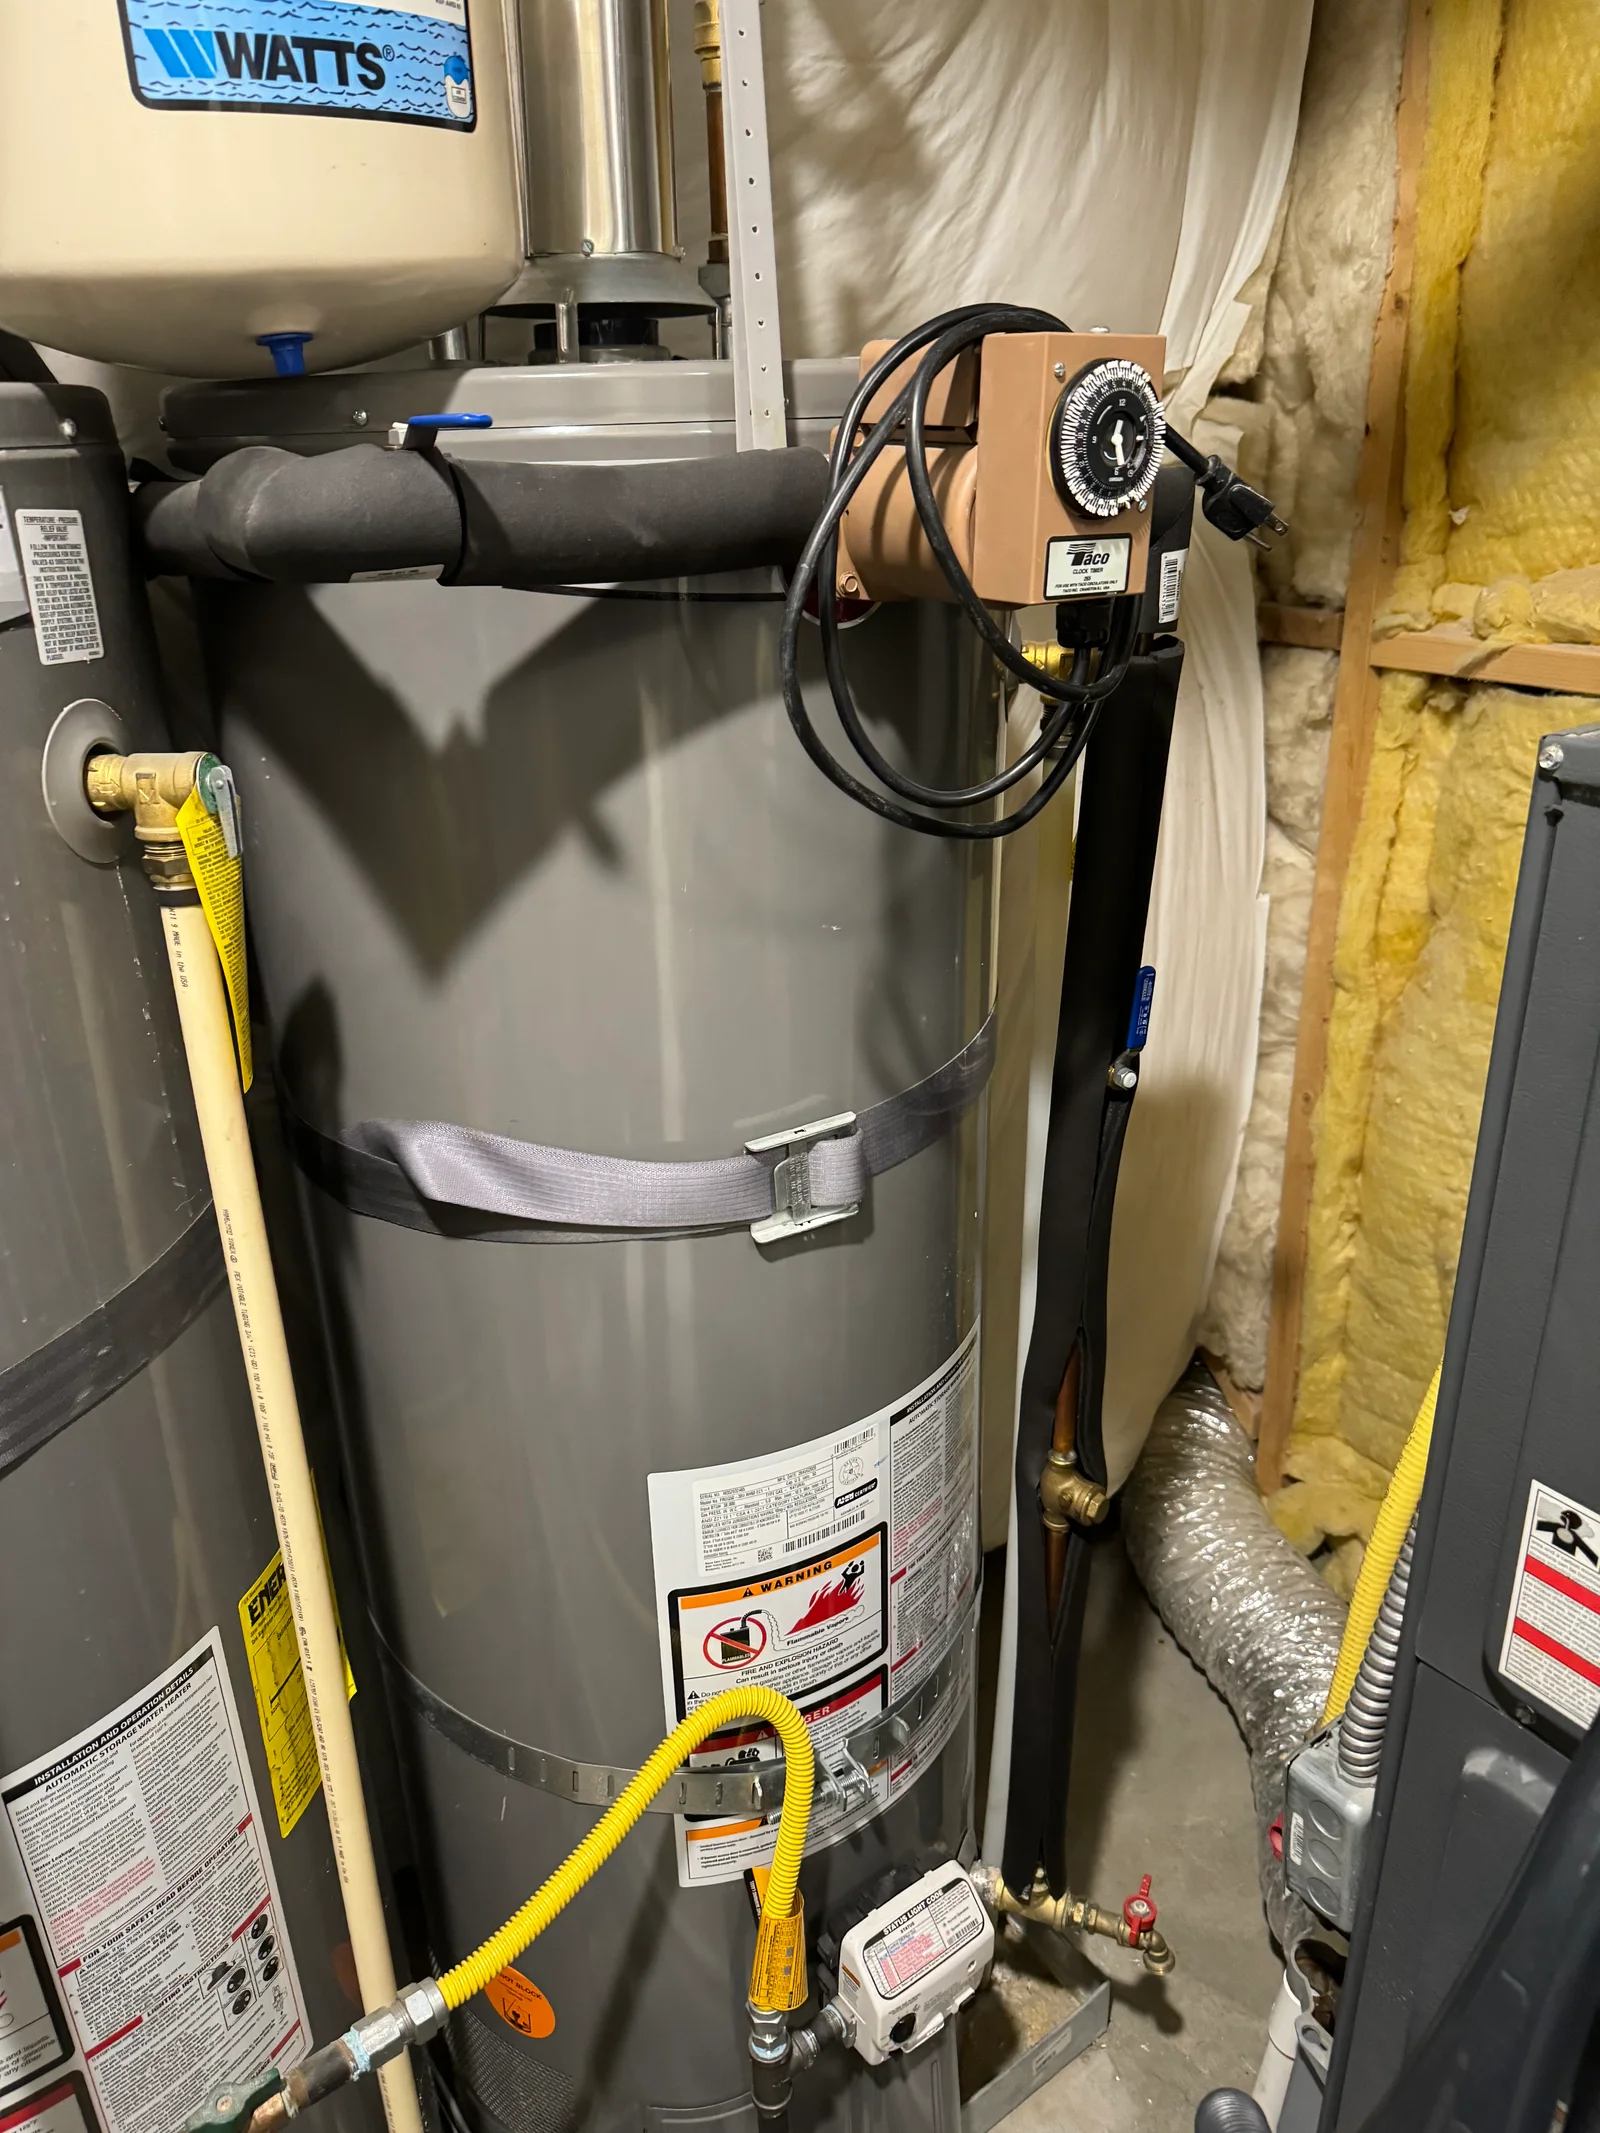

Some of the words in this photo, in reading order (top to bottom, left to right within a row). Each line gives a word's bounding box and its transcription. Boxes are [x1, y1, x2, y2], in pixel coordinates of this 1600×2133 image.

[760, 1562, 833, 1592] WARNING
[248, 1562, 286, 1627] ENER
[787, 1628, 825, 1646] Flammable
[826, 1616, 849, 1631] Vapors
[735, 1675, 749, 1684] Can
[750, 1669, 768, 1680] result
[777, 1659, 800, 1672] serious
[801, 1652, 819, 1664] injury
[741, 1667, 756, 1676] FIRE
[758, 1662, 773, 1671] AND
[774, 1649, 811, 1666] EXPLOSION
[812, 1637, 838, 1652] HAZARD
[758, 1672, 783, 1687] gasoline
[34, 1742, 99, 1785] INSTALLATION
[100, 1728, 118, 1746] AND
[120, 1692, 165, 1729] OPERATION
[165, 1667, 194, 1696] DETAILS
[804, 1706, 831, 1723] GER
[45, 1756, 98, 1792] AUTOMATIC
[100, 1728, 137, 1758] STORAGE
[137, 1705, 164, 1729] WATER
[165, 1683, 192, 1710] HEATER
[33, 1860, 50, 1873] Water
[51, 1845, 75, 1862] Leakage
[83, 1949, 99, 1962] FOR
[102, 1933, 124, 1950] YOUR
[126, 1909, 154, 1936] SAFETY
[156, 1892, 176, 1910] READ
[177, 1866, 203, 1897] BEFORE
[204, 1833, 238, 1870] OPERATING
[883, 1916, 908, 1936] STATUS
[907, 1902, 926, 1918] LIGHT
[926, 1889, 944, 1904] CODE
[900, 1922, 915, 1933] STATUS
[147, 1990, 181, 2017] LIGHTING
[182, 1944, 229, 1989] INSTRUCTIONS
[516, 1982, 542, 2000] BLOCK
